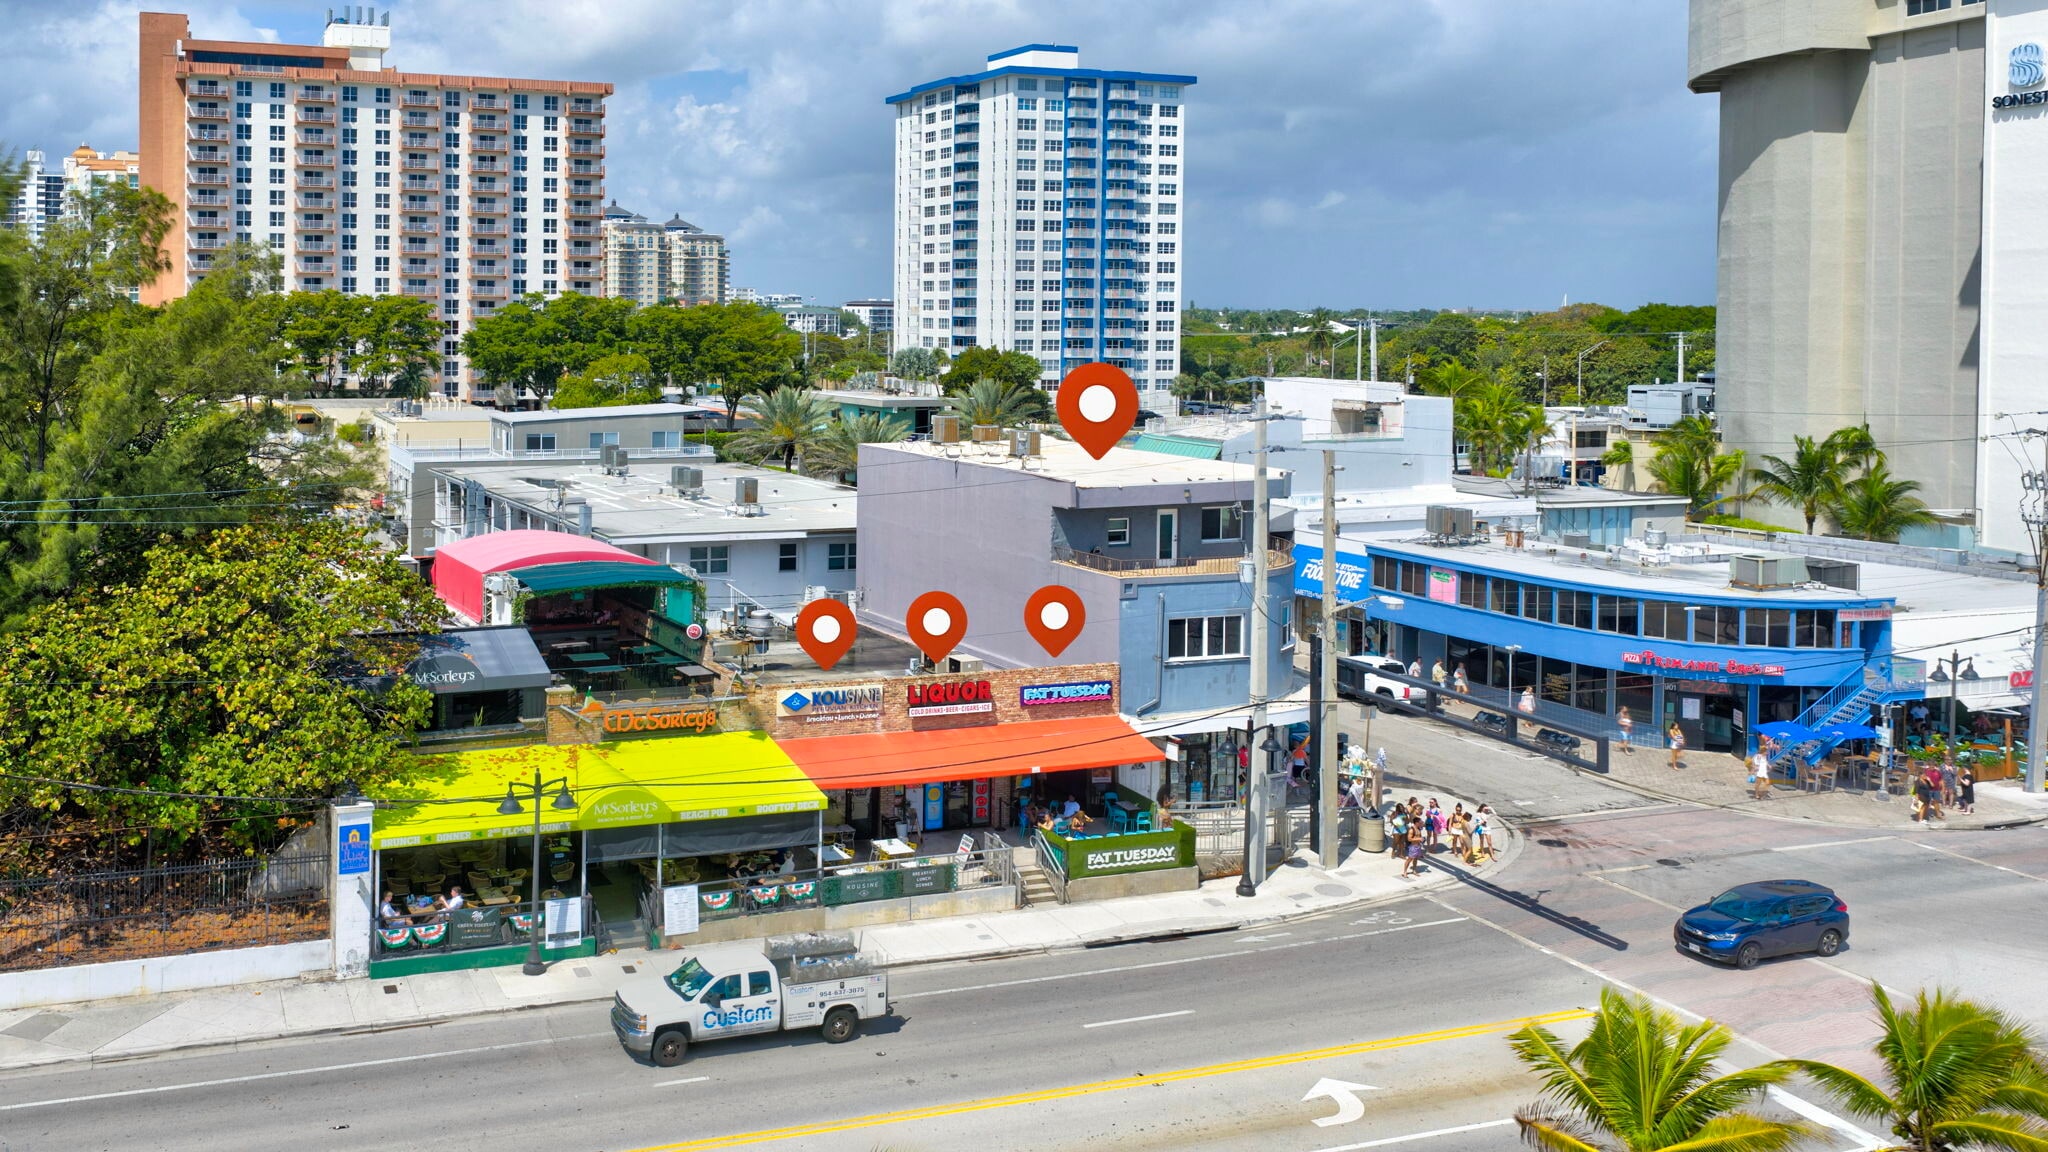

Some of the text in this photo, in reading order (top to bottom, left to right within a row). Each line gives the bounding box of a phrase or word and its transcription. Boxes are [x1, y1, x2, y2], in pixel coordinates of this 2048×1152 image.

[1336, 569, 1365, 589] TORE
[1624, 653, 1640, 663] PIZZA
[414, 670, 475, 684] McSorley's
[811, 688, 880, 706] KOUSINE
[907, 681, 992, 705] LIQUOR
[1024, 683, 1111, 700] FAT TUESDAY
[961, 704, 980, 712] CIGARS
[981, 703, 990, 711] ICE
[680, 808, 728, 820] BEACH PUB
[756, 801, 819, 813] ROOFTOP DECK
[380, 836, 420, 848] BRUNCH
[436, 832, 471, 842] DINNER
[502, 825, 533, 836] FLOOR
[540, 822, 571, 833] OUNGE
[1087, 846, 1175, 864] FAT TUESDAY
[846, 882, 879, 890] KOUSINE
[703, 1006, 772, 1029] Custom
